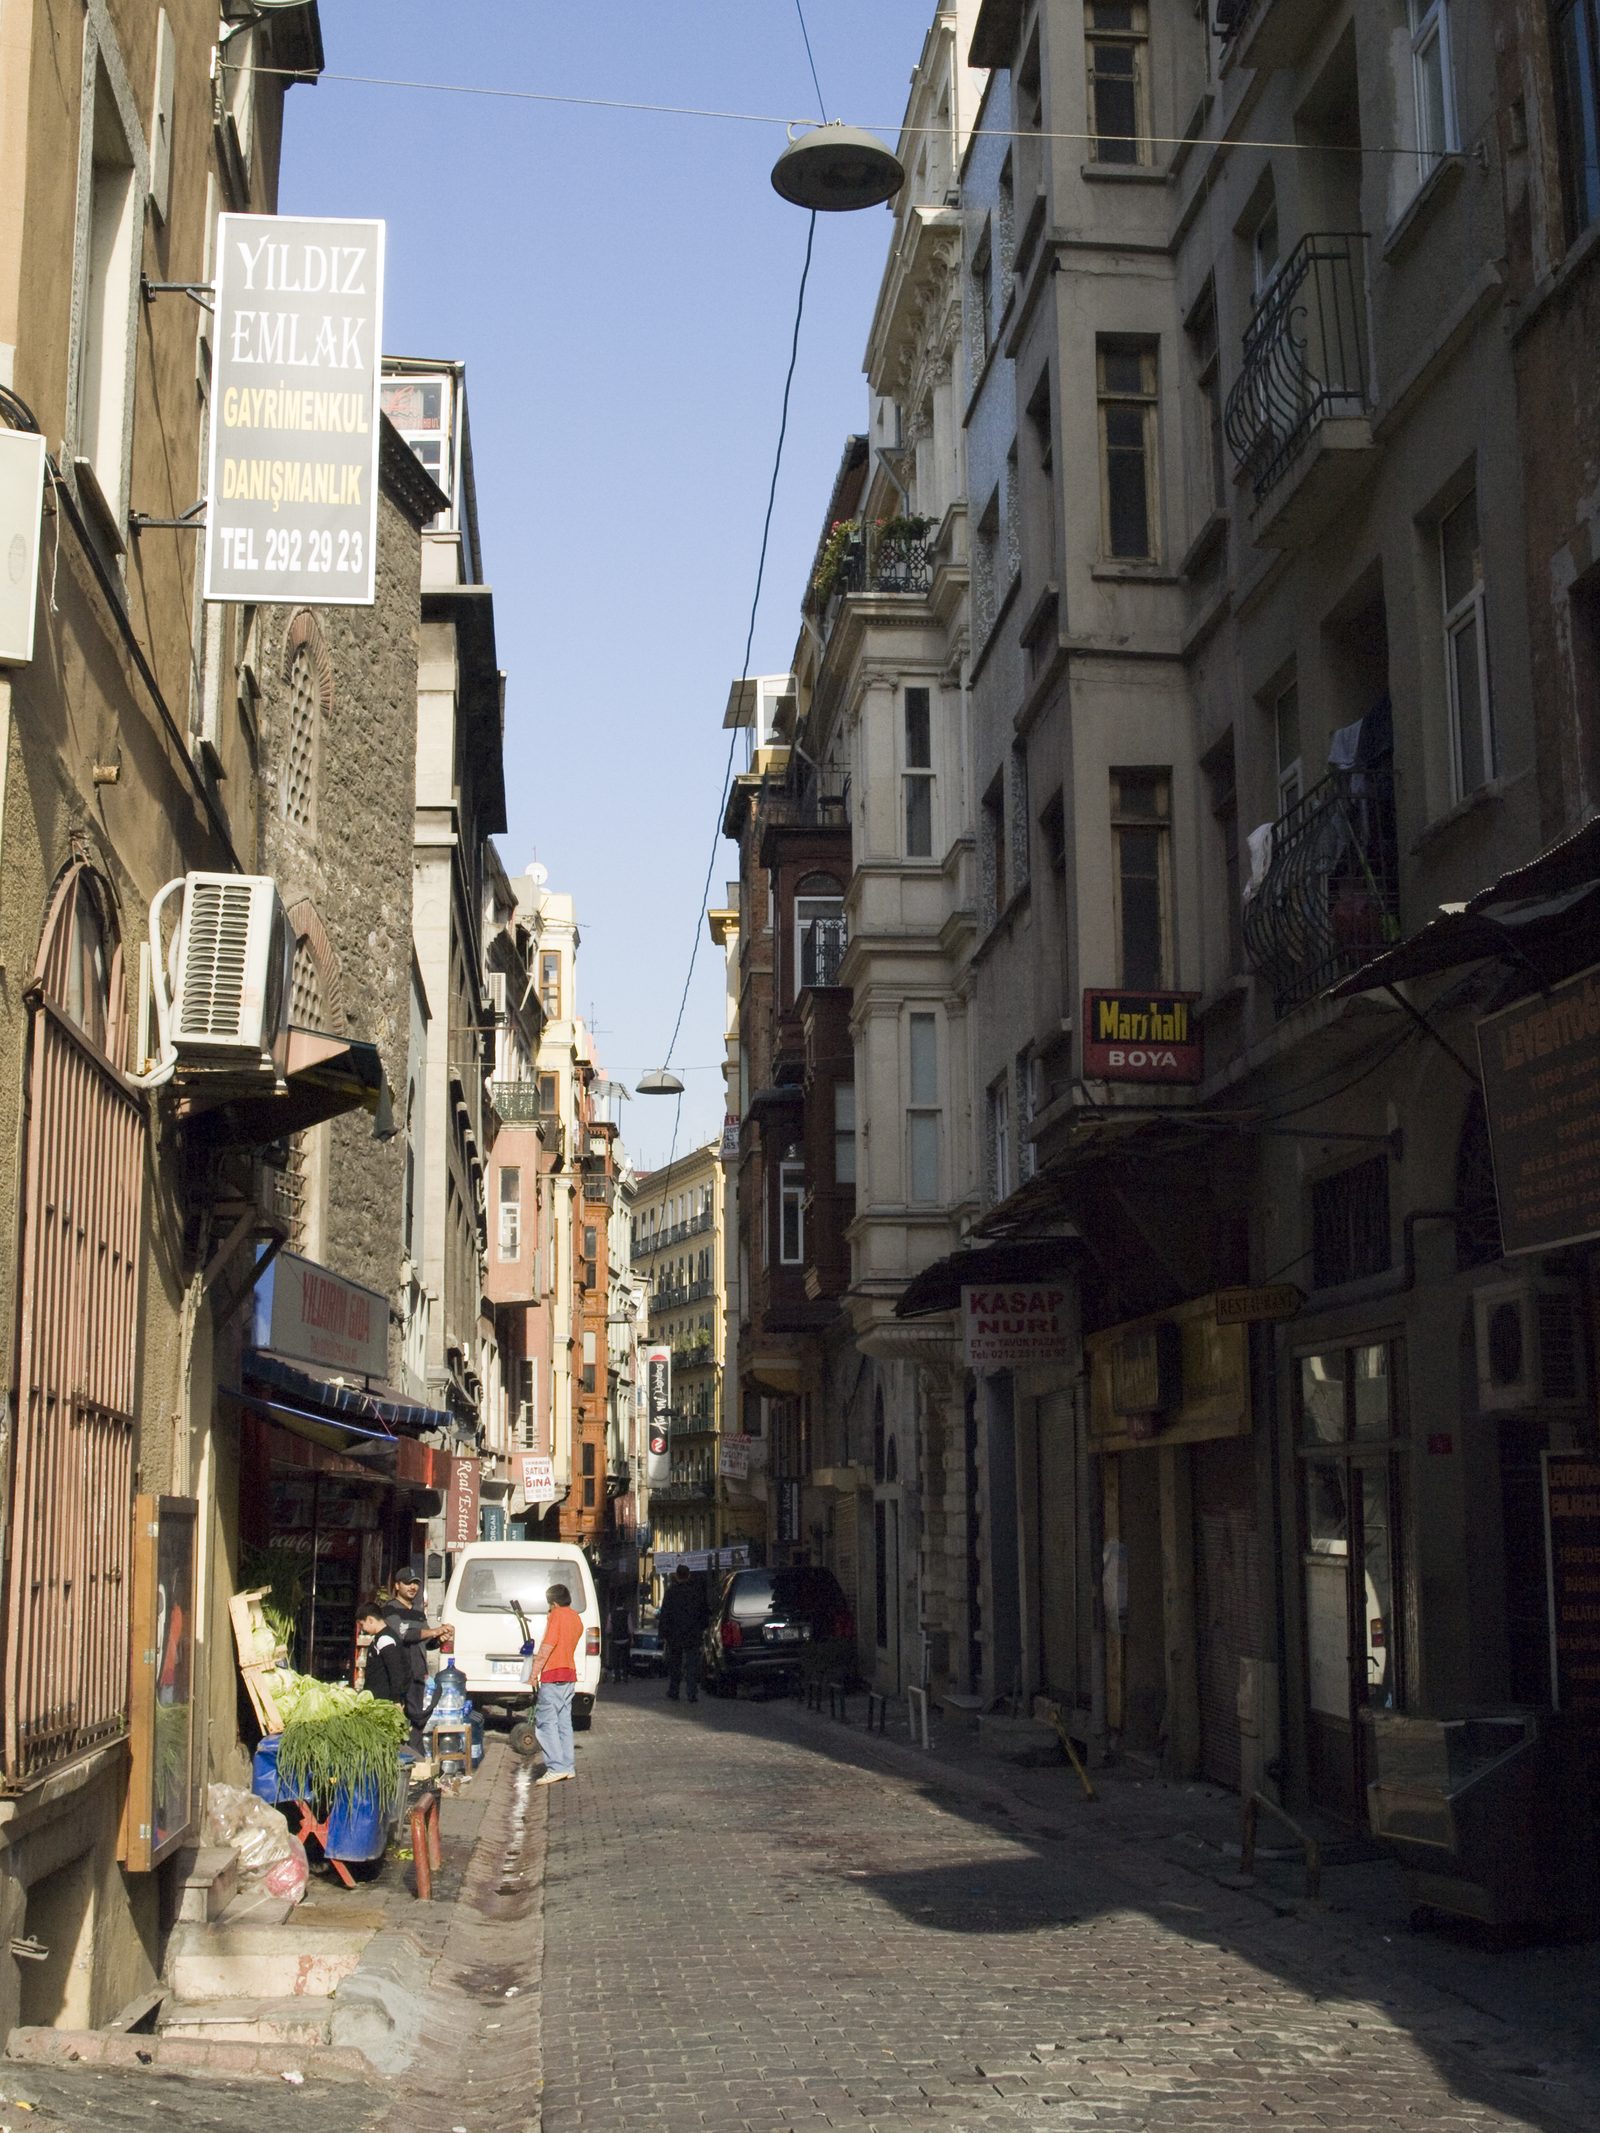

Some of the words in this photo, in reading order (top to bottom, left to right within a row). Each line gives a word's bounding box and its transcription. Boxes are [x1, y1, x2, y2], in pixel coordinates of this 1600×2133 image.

[236, 233, 367, 295] YILDIZ
[230, 310, 367, 370] EMLAK
[223, 380, 368, 434] GAYRİMENKUL
[222, 457, 362, 513] DANIŞMANLIK
[220, 526, 259, 571] TEL
[264, 528, 302, 572] 292
[308, 529, 332, 573] 29
[336, 530, 363, 574] 23
[1099, 1000, 1187, 1040] Marshall
[1109, 1051, 1177, 1067] BOYA
[969, 1290, 1065, 1314] KASAP
[456, 1460, 474, 1495] Real
[457, 1495, 472, 1541] Estate
